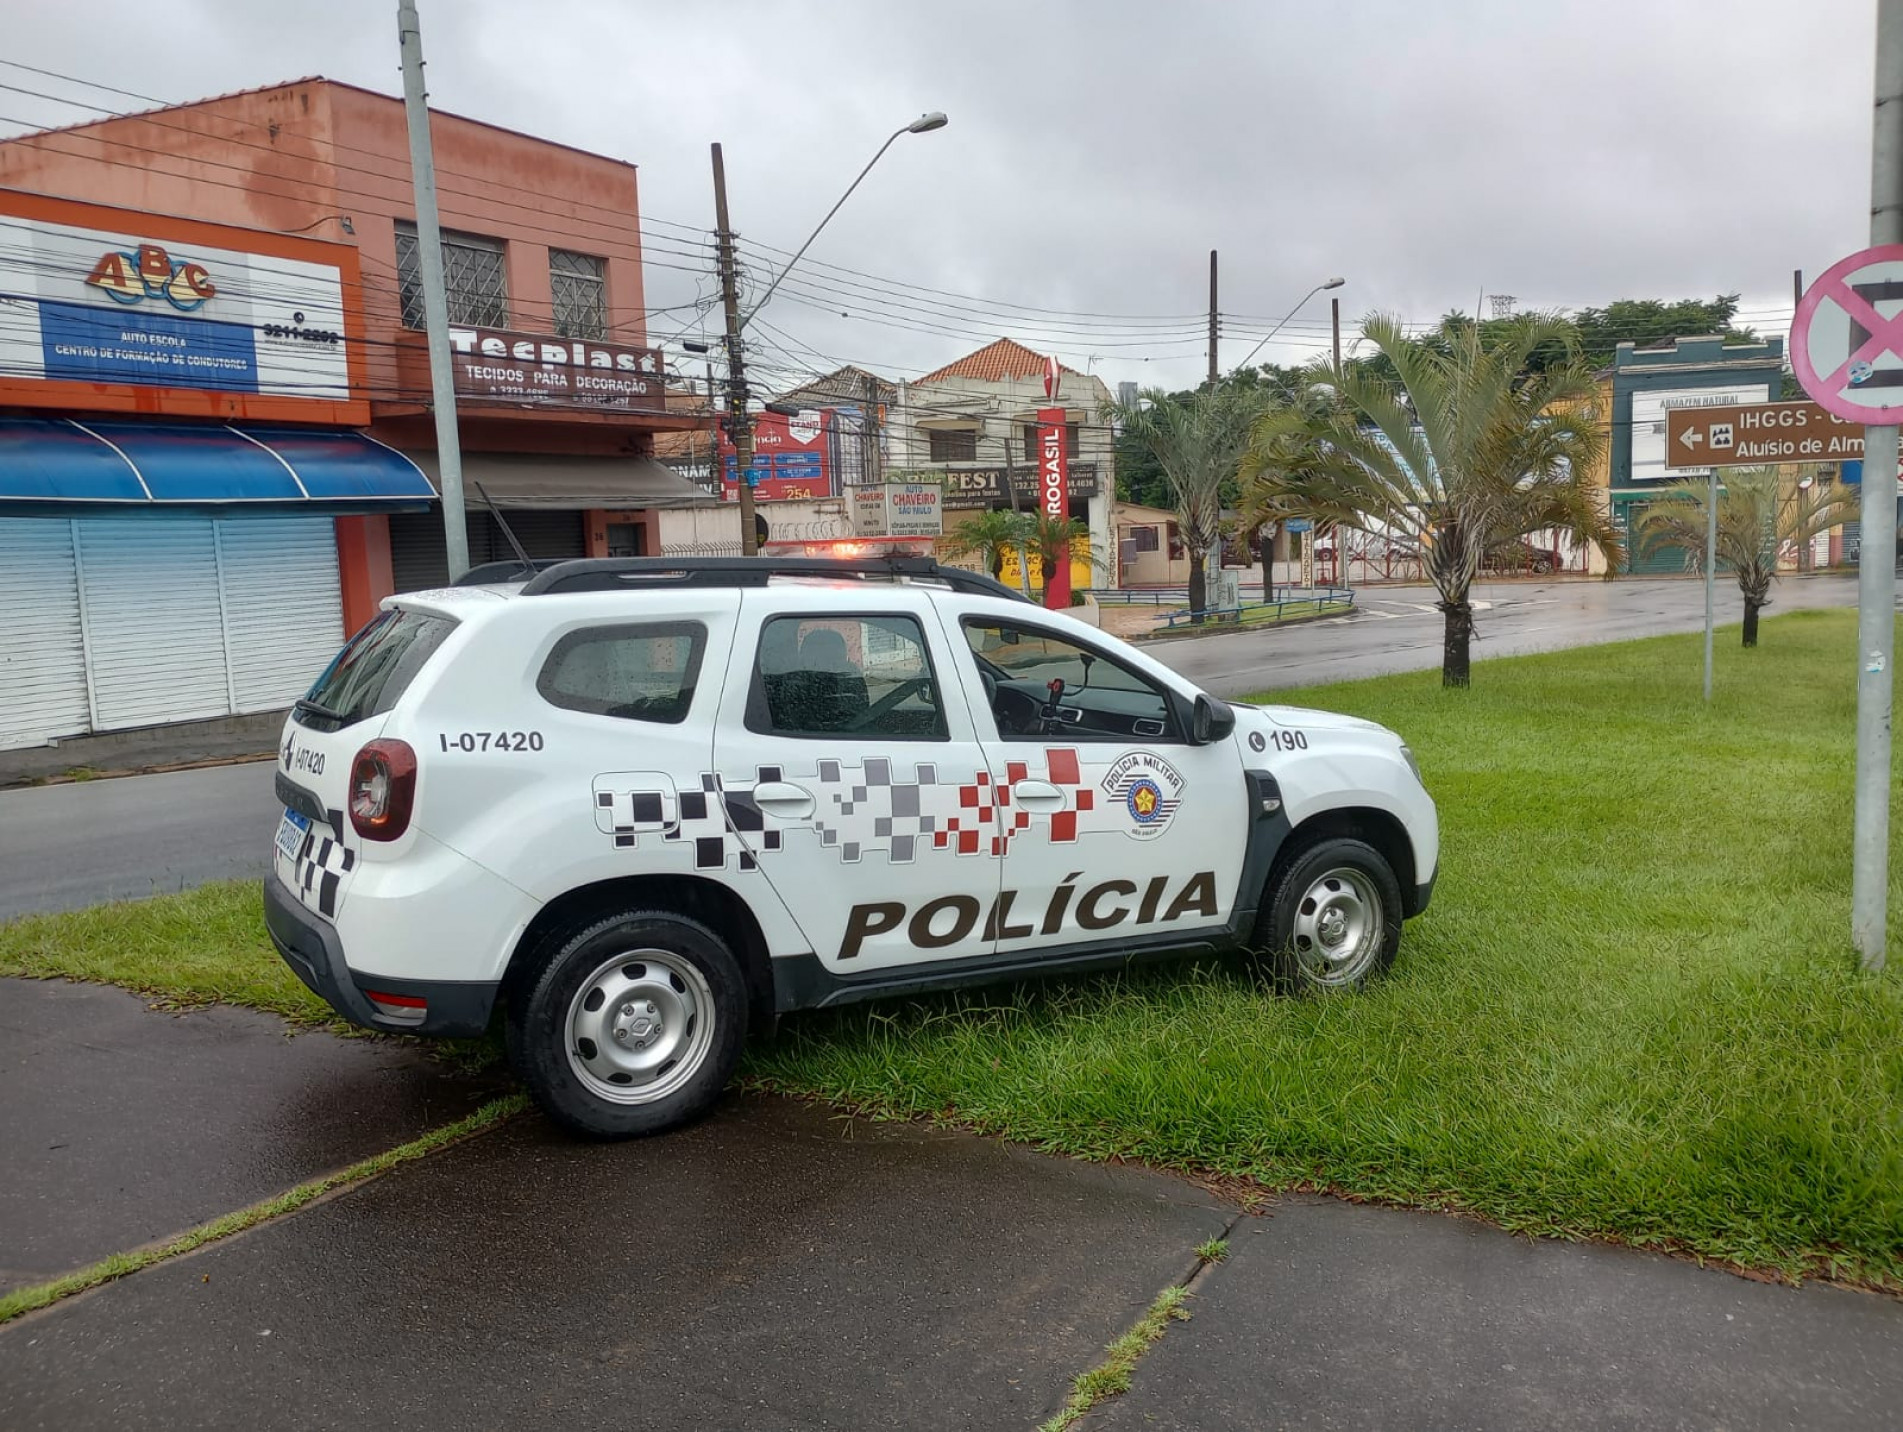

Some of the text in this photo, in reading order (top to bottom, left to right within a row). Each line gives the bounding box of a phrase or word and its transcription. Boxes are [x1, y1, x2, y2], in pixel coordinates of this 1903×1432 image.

[85, 244, 215, 298] ABC
[121, 332, 187, 347] AUTO ESCOLA
[449, 328, 656, 373] Tecplast
[55, 344, 248, 370] CENTRO DE FORMAÇÃO DE CONDUTORES
[465, 365, 647, 394] TECIDOS PARA DECORAÇÃO
[1740, 410, 1807, 429] IHGGS
[1736, 438, 1795, 457] Aluísio
[1800, 437, 1823, 453] de
[1045, 428, 1061, 522] ROGASIL
[855, 493, 884, 502] CHAVEIRO
[893, 494, 936, 506] CHAVEIRO
[440, 731, 544, 752] I-07420
[1270, 731, 1308, 751] 190
[295, 747, 326, 775] I-07420
[1107, 756, 1180, 790] POLÍCIA MILITAR
[837, 872, 1218, 960] POLÍCIA
